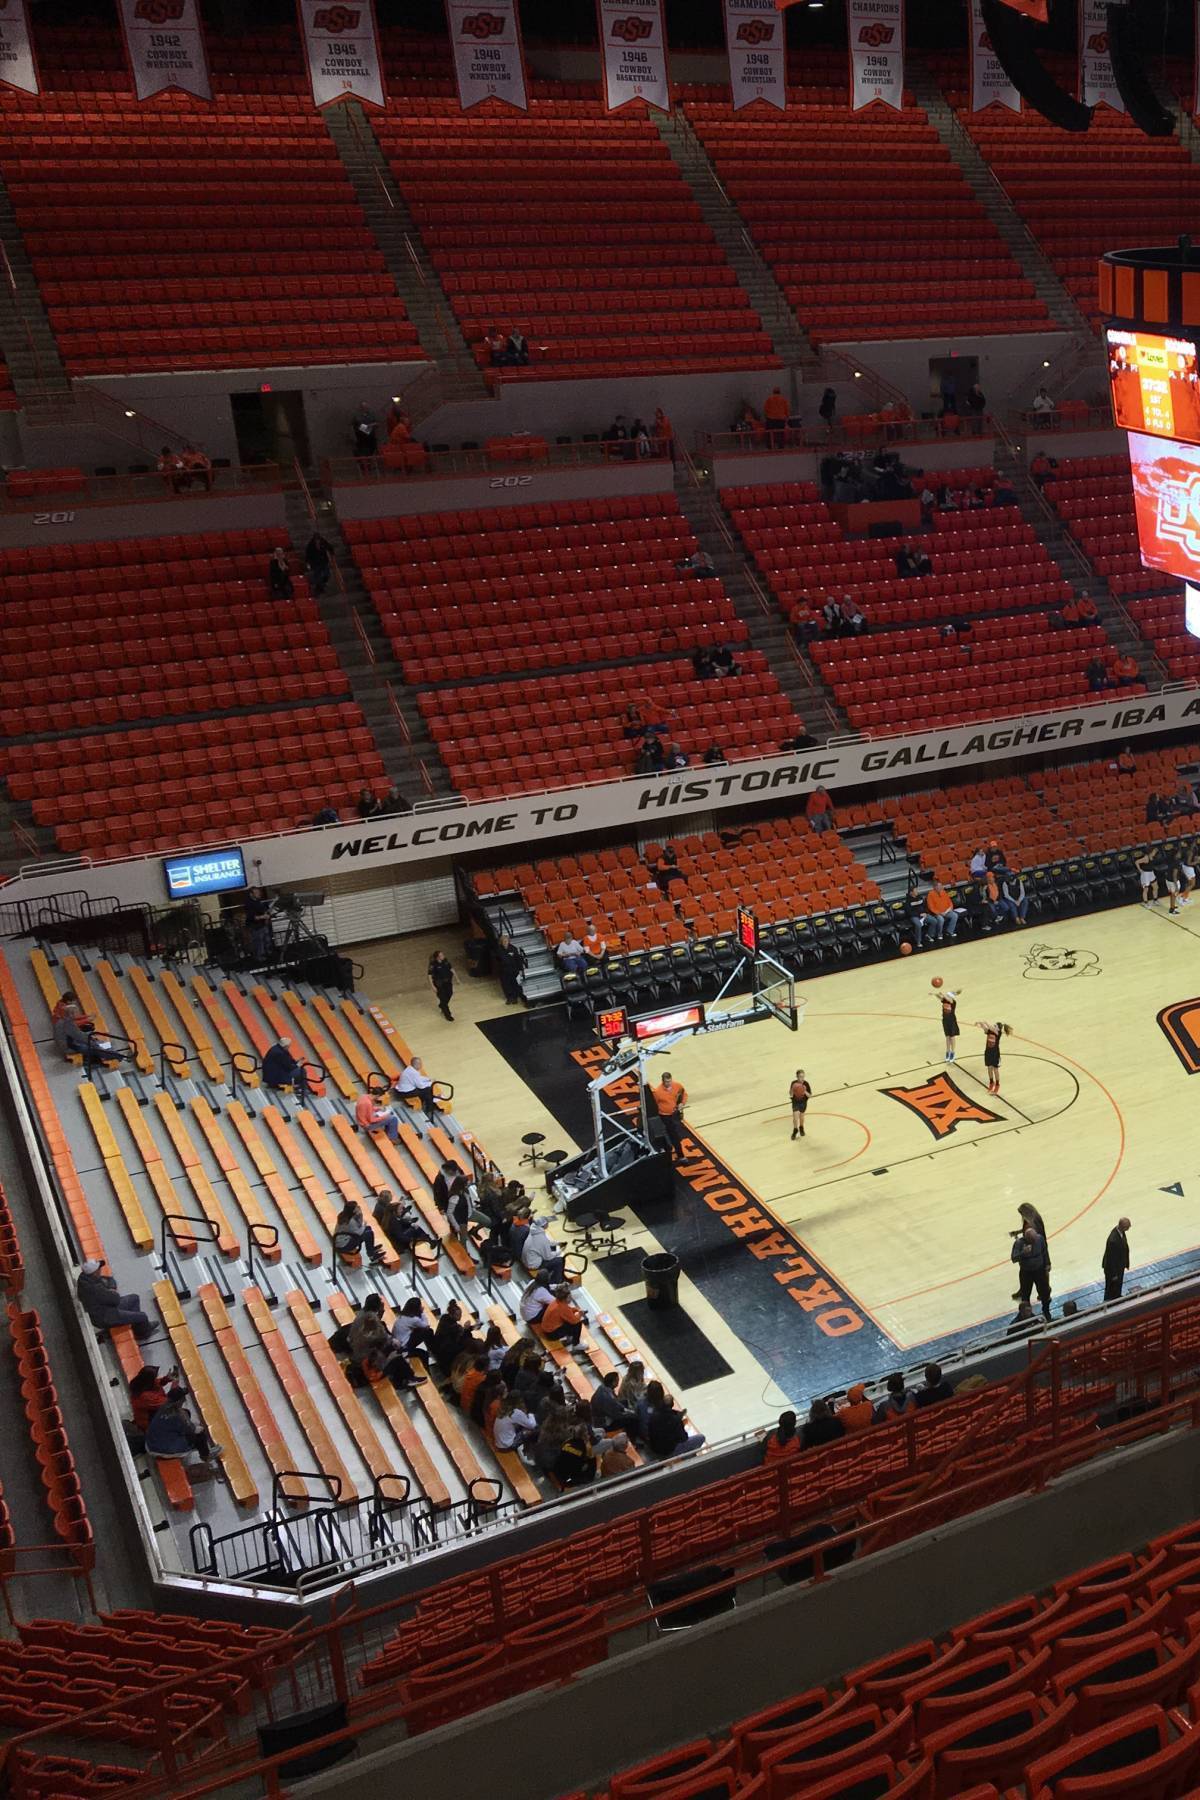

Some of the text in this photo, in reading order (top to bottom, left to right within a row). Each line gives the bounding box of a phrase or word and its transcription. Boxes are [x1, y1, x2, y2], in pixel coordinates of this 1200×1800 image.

[729, 0, 775, 9] CHAMPION
[852, 2, 899, 13] CHAMPIONS
[313, 6, 360, 33] OSU
[461, 12, 506, 38] OSU
[611, 16, 653, 42] OSU
[736, 20, 775, 44] OSU
[858, 23, 895, 46] OSU
[150, 35, 180, 47] 1942
[328, 44, 356, 55] 1945
[473, 49, 501, 60] 1946
[147, 51, 187, 60] COWBOY
[622, 51, 648, 62] 1946
[746, 54, 769, 65] 1948
[866, 56, 888, 66] 1949
[146, 61, 193, 69] WRESTLING
[325, 58, 362, 67] COWBOY
[471, 63, 506, 72] COWBOY
[321, 68, 370, 76] BASKETBALL
[619, 65, 652, 74] COWBOY
[743, 67, 773, 76] COWBOY
[863, 69, 891, 77] COWBOY
[469, 72, 511, 80] WRESTLING
[616, 73, 658, 82] BASKETBALL
[741, 75, 777, 83] WRESTLING
[861, 77, 894, 85] WRESTLING
[490, 476, 533, 488] 202
[32, 512, 75, 525] 201
[331, 814, 517, 860] WELCOME
[531, 804, 578, 826] TO
[638, 758, 839, 810] HISTORIC
[860, 703, 1166, 772] GALLAGHER-IBA
[193, 859, 240, 875] SHELTER
[194, 869, 244, 882] INSURANCE
[605, 1022, 620, 1035] 30
